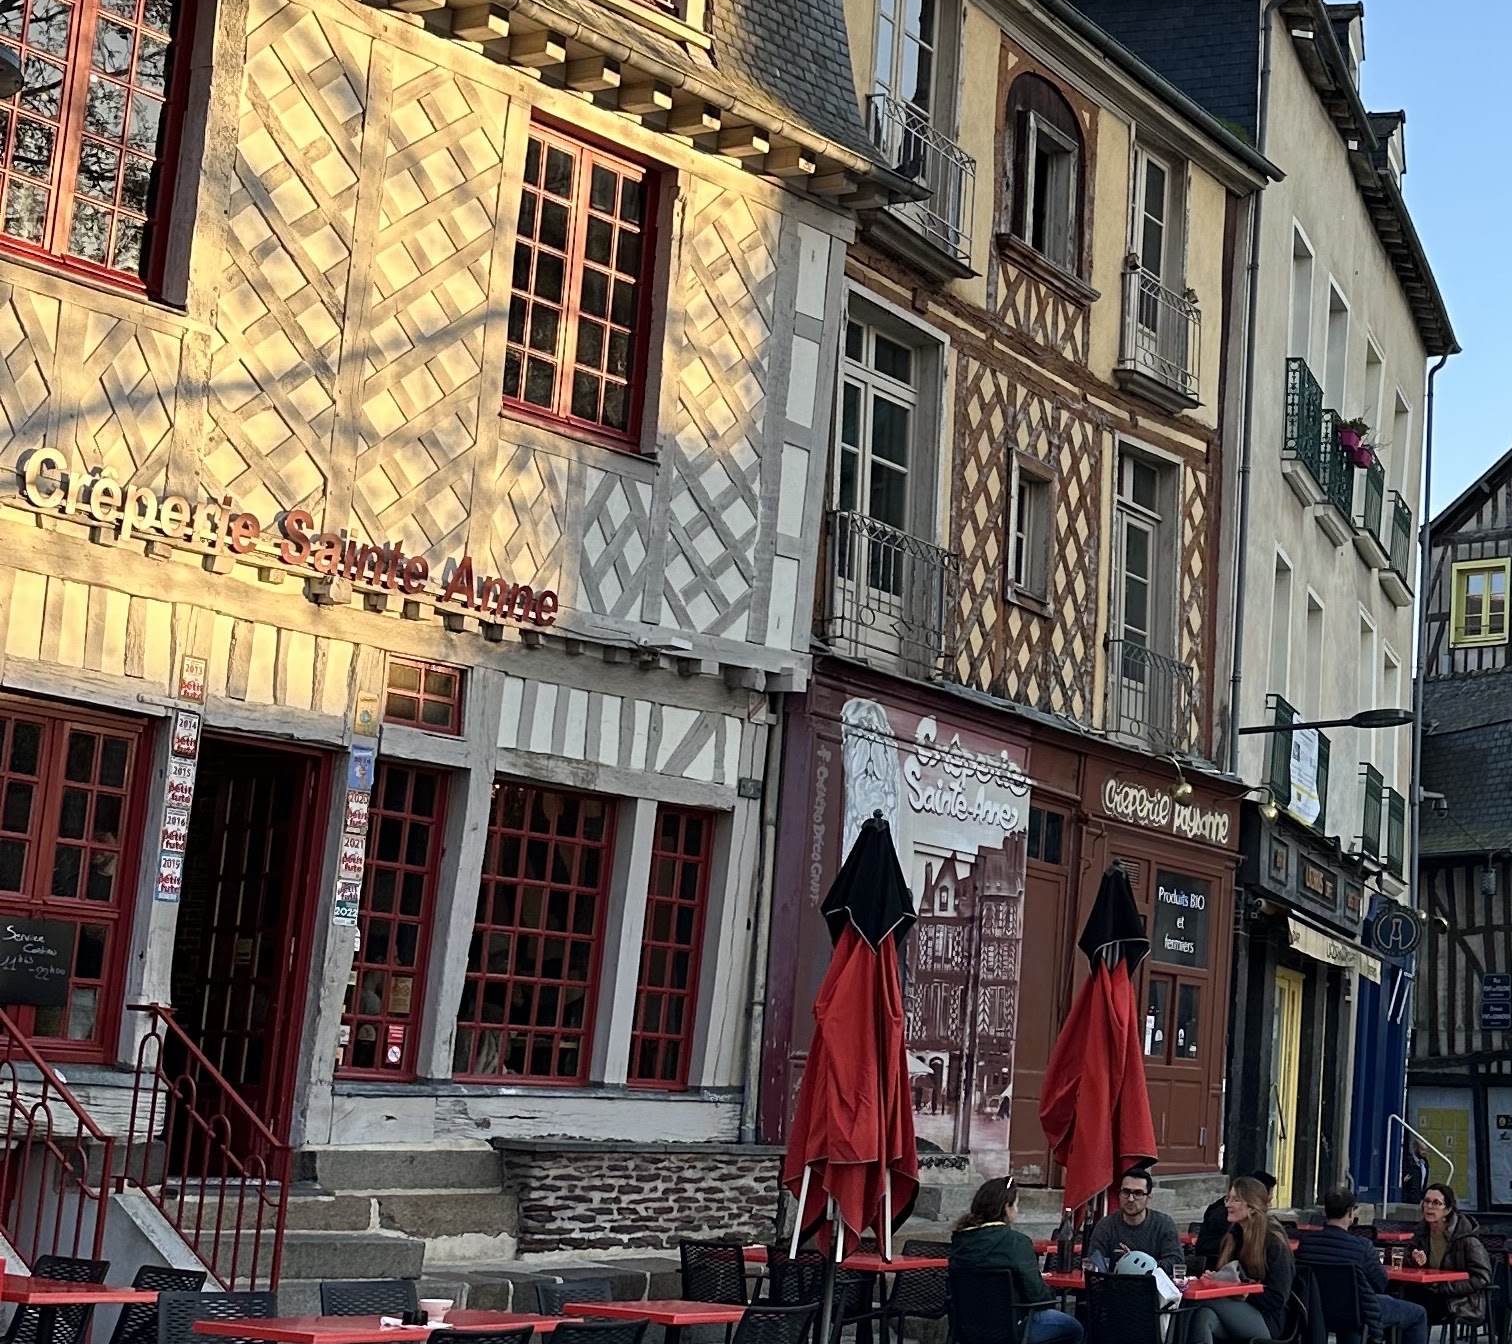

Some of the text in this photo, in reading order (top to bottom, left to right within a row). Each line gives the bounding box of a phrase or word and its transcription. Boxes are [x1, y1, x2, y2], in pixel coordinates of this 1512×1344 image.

[25, 447, 559, 626] Crêperie Sainte Anne
[186, 664, 202, 675] 2013
[179, 718, 196, 730] 2014
[173, 766, 191, 777] 2015
[903, 755, 1019, 830] Sainte-Anne
[166, 816, 186, 826] 2016
[344, 838, 363, 849] 2021
[162, 858, 180, 869] 2019
[1158, 886, 1205, 910] Produits BIO
[334, 907, 358, 916] 2022
[1176, 916, 1185, 930] et
[3, 925, 45, 942] Service
[1164, 933, 1194, 954] fermiers
